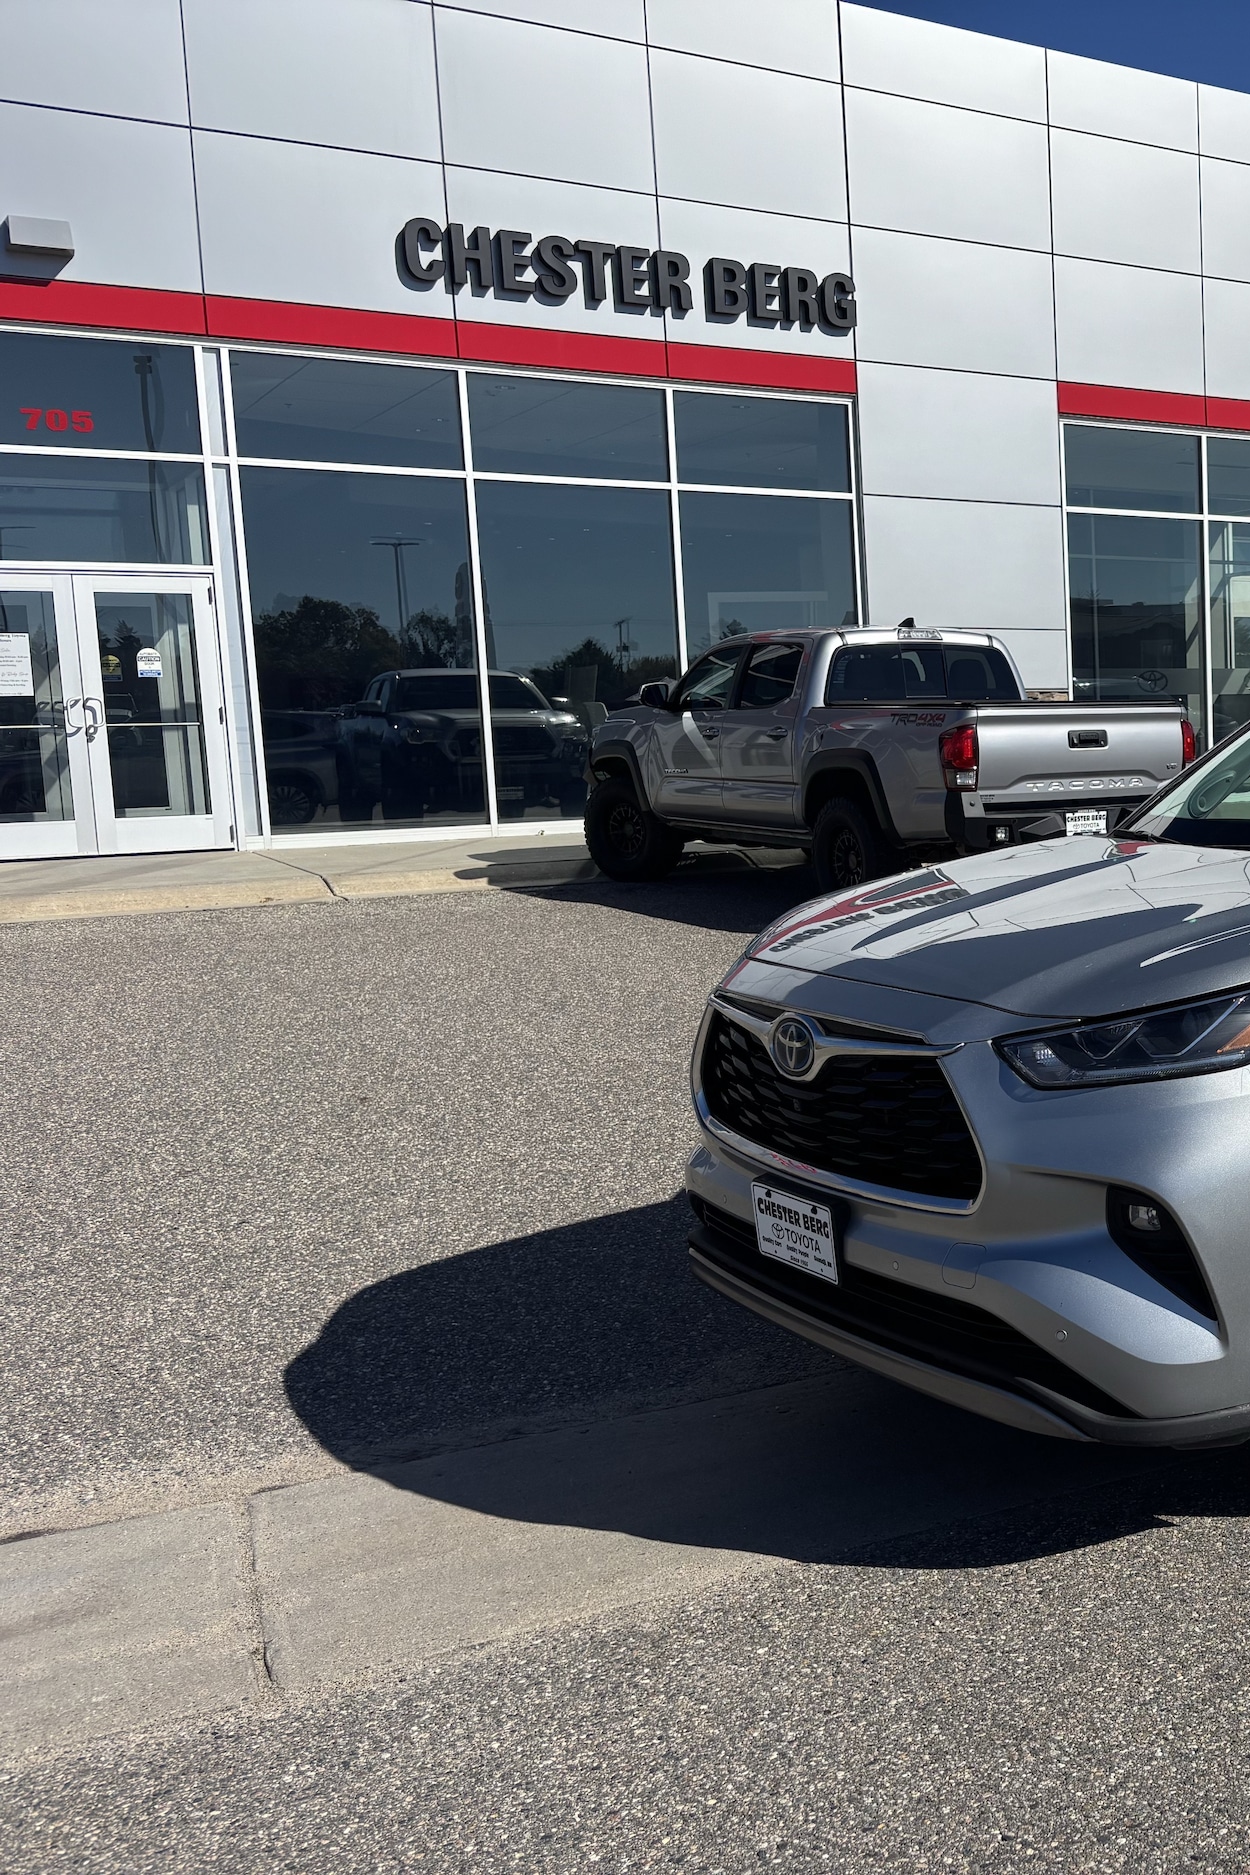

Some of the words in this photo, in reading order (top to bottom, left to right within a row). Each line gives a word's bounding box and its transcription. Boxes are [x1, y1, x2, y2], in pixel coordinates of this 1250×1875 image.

[397, 217, 693, 317] CHESTER
[703, 257, 858, 334] BERG
[19, 407, 94, 433] 705
[890, 713, 918, 726] TRD
[1026, 777, 1143, 792] TACOMA
[757, 1197, 802, 1228] CHESTER
[802, 1213, 830, 1239] BERG
[784, 1227, 822, 1254] TOYOTA
